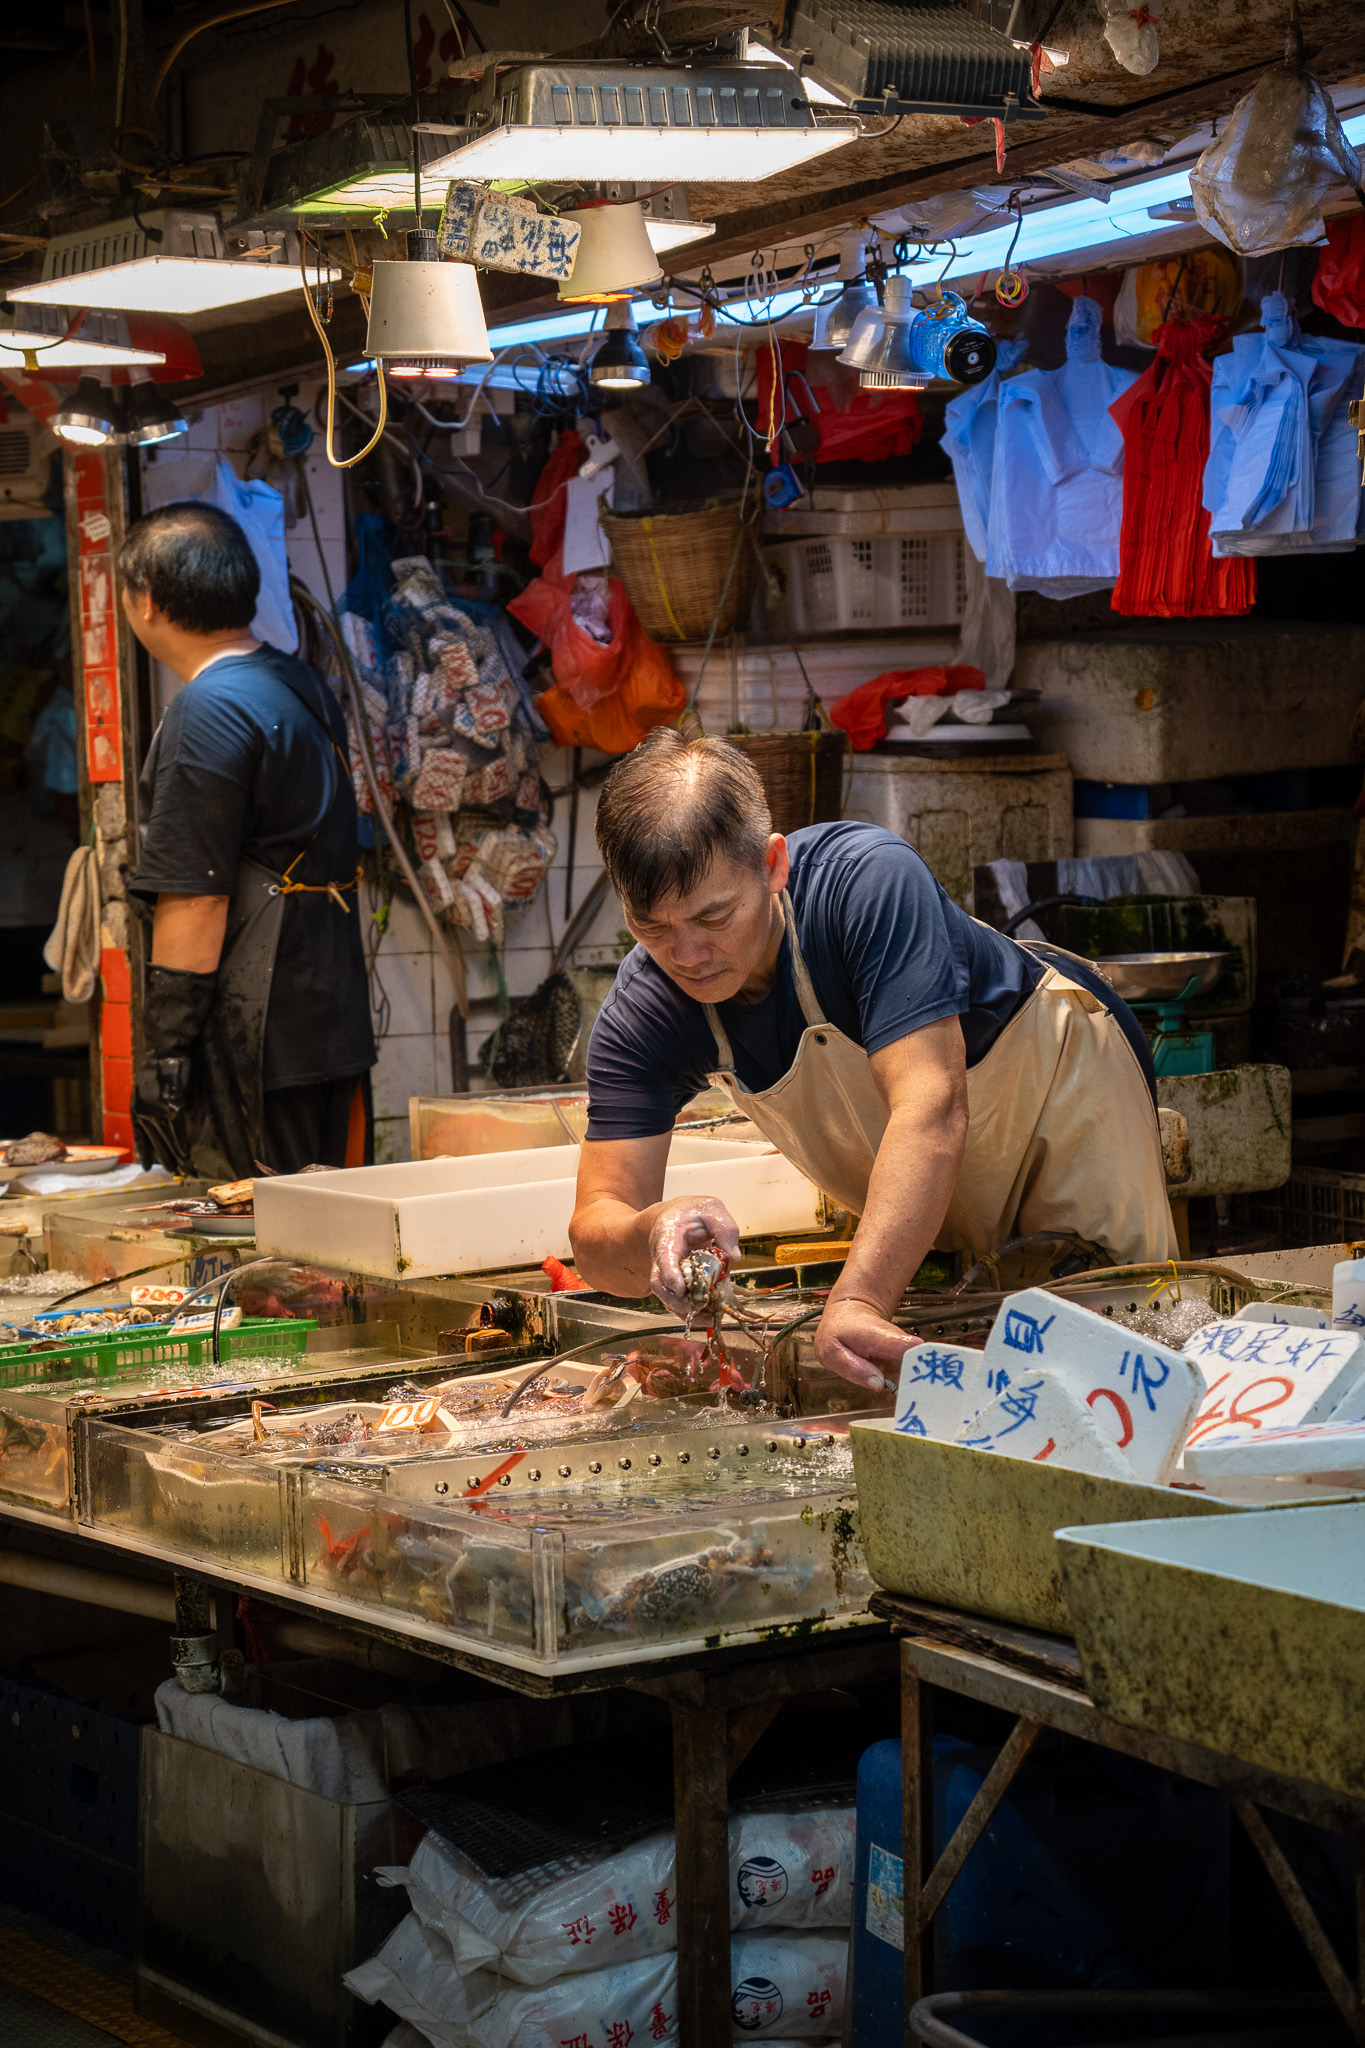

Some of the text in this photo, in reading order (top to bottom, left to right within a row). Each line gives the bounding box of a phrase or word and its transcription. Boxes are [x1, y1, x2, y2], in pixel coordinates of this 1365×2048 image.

[413, 817, 438, 861] 120
[136, 1286, 184, 1303] 200
[372, 1397, 441, 1432] 100
